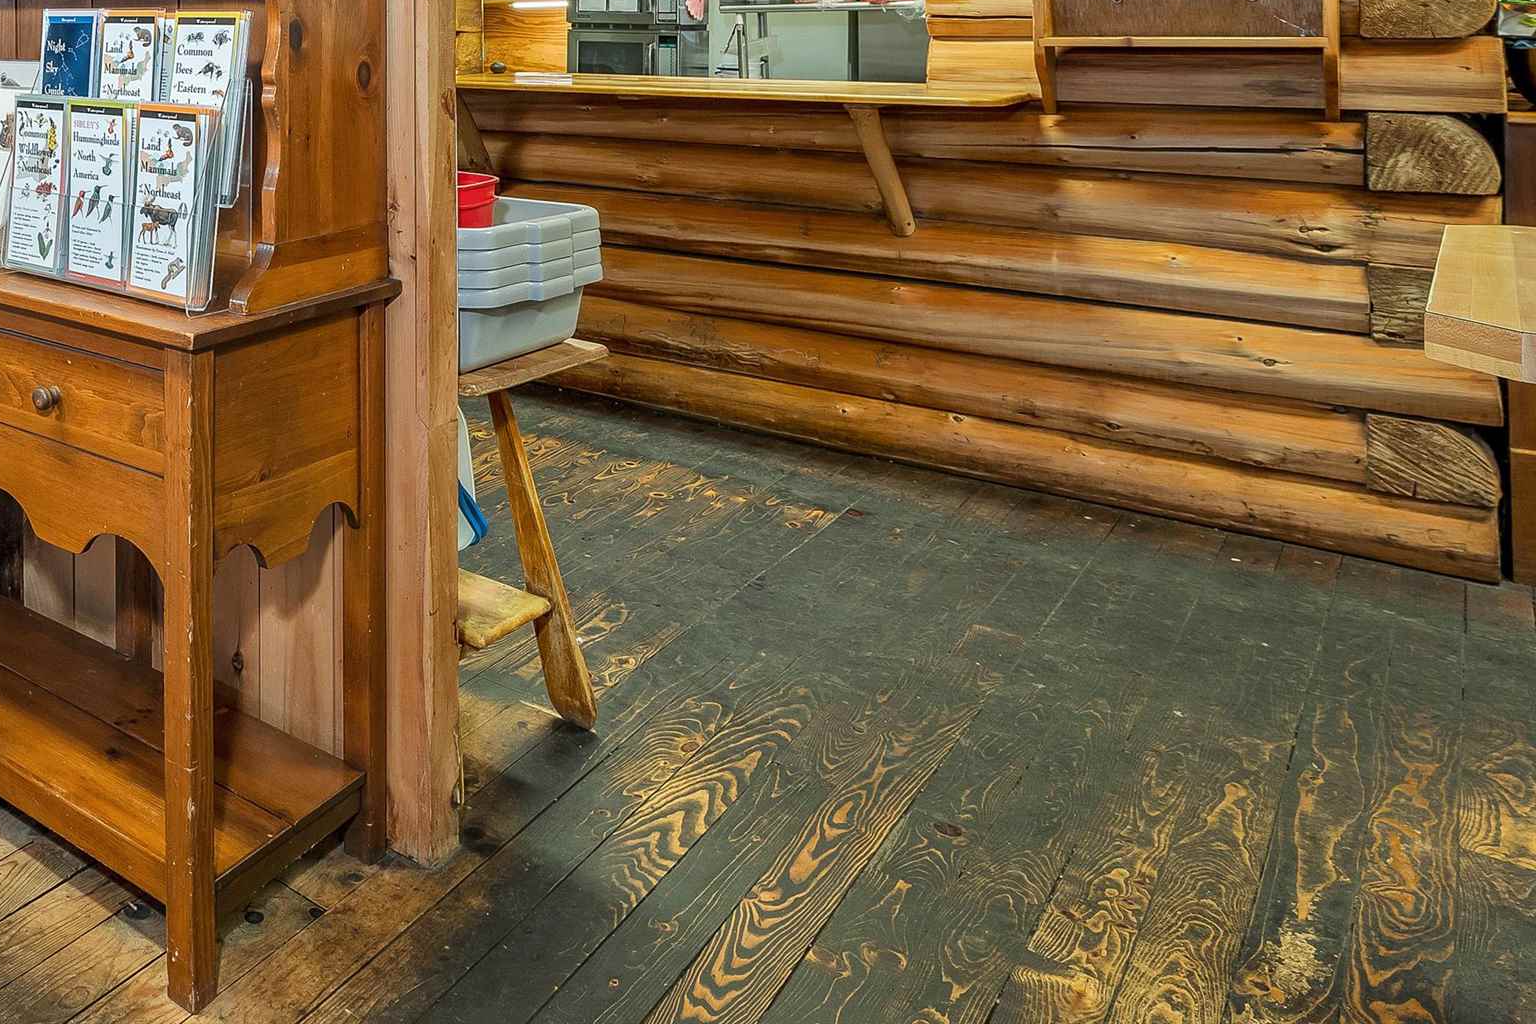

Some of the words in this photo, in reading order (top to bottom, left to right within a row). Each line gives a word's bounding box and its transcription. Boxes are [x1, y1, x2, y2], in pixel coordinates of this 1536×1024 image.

[46, 38, 66, 54] Night
[105, 40, 124, 54] Land
[177, 44, 214, 57] Common
[45, 60, 59, 76] Sky
[104, 62, 138, 76] Mammals
[175, 62, 193, 75] Bees
[106, 84, 141, 97] Northeast
[177, 81, 207, 94] Eastern
[73, 131, 120, 146] Hummingbirds
[141, 137, 162, 152] Land
[18, 142, 57, 158] Wildflowers
[77, 149, 96, 162] North
[73, 167, 99, 181] America
[140, 160, 177, 177] Mammals
[143, 183, 182, 201] Northeast
